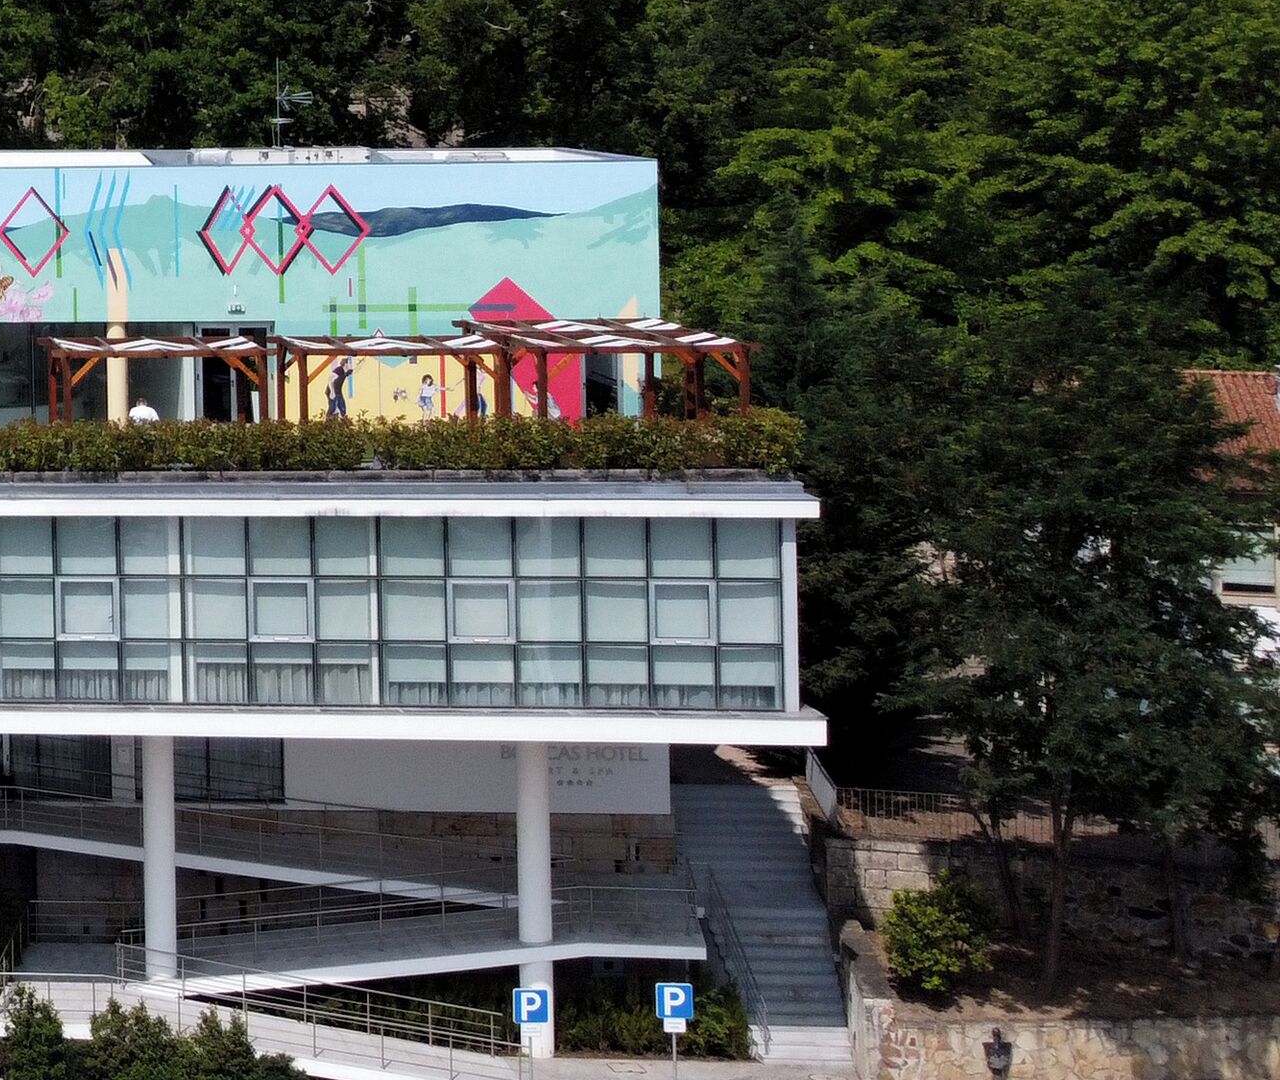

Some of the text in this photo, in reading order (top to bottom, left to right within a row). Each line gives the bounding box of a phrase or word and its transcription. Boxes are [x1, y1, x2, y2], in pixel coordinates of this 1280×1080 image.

[587, 746, 648, 762] HOTEL
[520, 991, 542, 1021] P
[663, 986, 686, 1016] P
